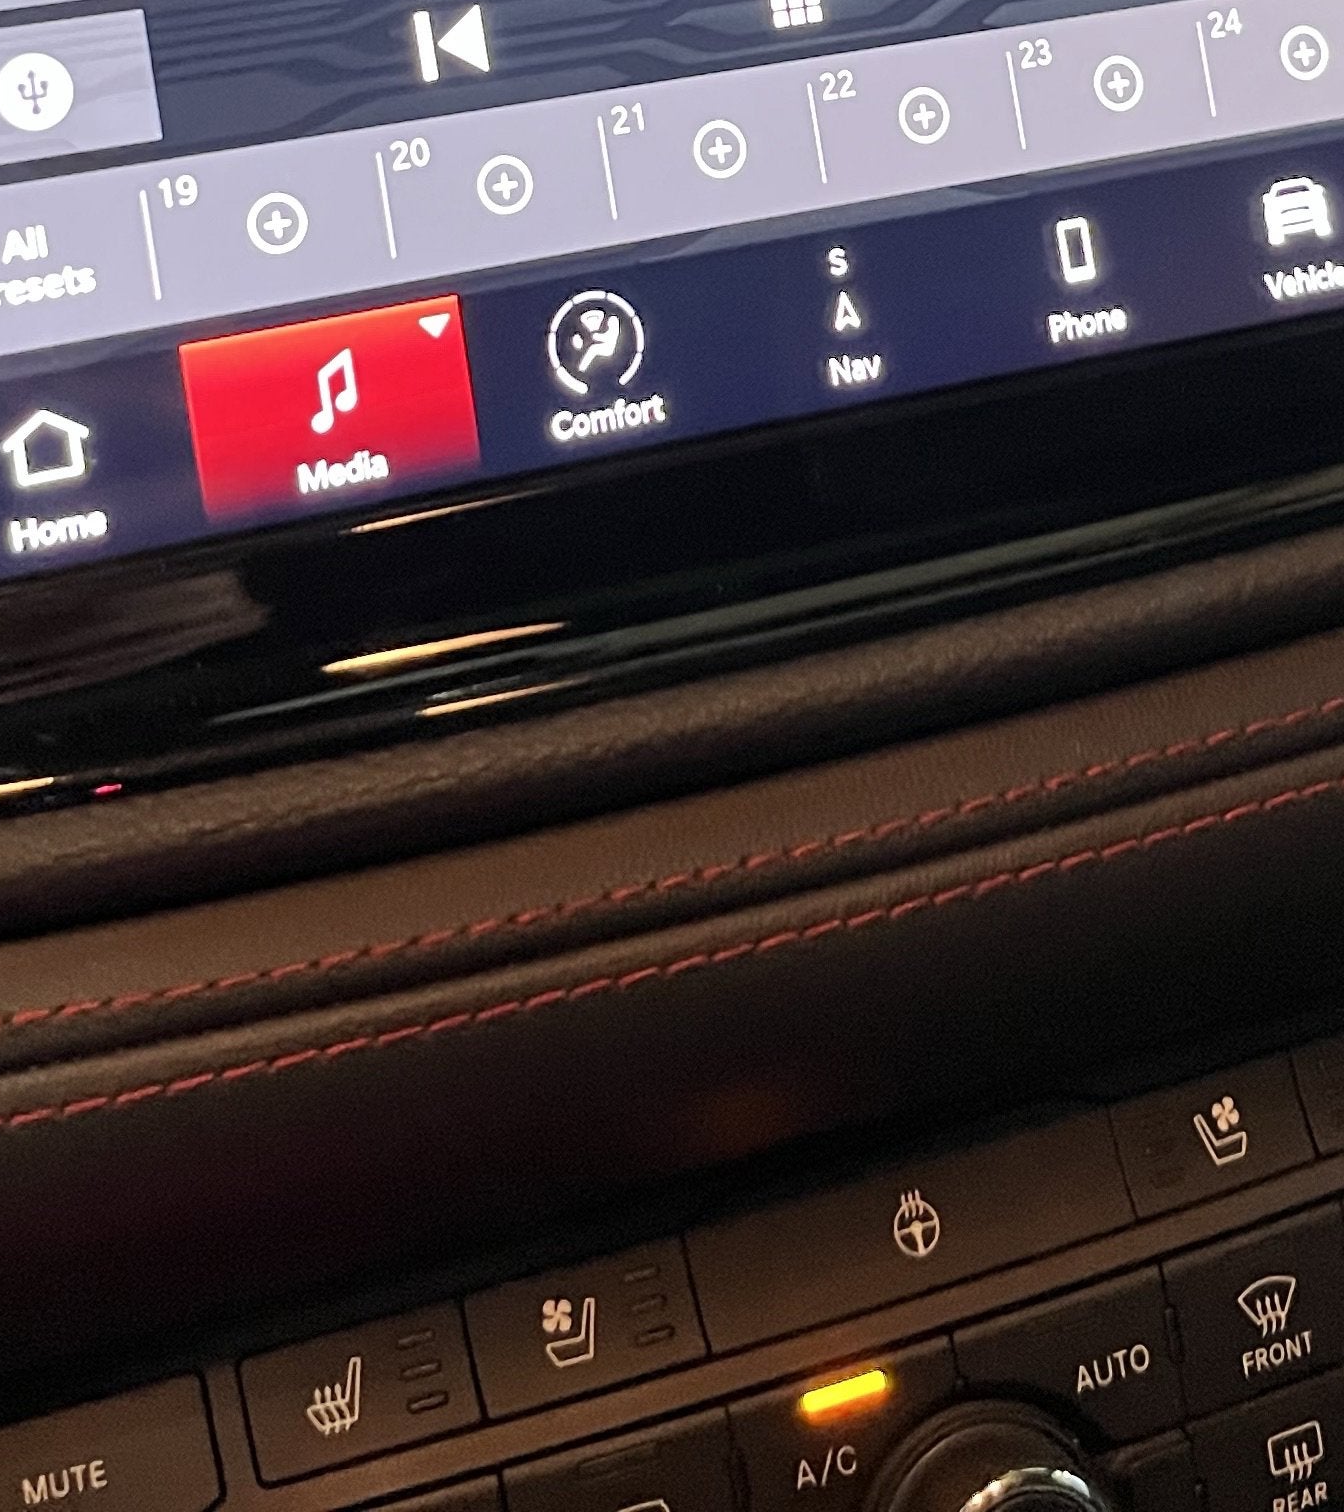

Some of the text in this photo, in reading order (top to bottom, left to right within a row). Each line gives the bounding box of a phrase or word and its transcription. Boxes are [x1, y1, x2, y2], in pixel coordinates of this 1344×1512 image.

[1206, 6, 1244, 40] 24
[1017, 37, 1054, 71] 23
[818, 68, 858, 103] 22
[609, 101, 646, 137] 21
[388, 136, 432, 173] 20
[156, 173, 199, 210] 19
[0, 223, 50, 266] All
[1046, 307, 1129, 345] Phone
[826, 353, 883, 388] Nav
[548, 395, 667, 444] Comfort
[295, 449, 391, 496] Media
[6, 509, 109, 555] Home
[1076, 1343, 1151, 1394] AUTO
[1241, 1331, 1312, 1379] FRONT
[20, 1458, 109, 1506] MUTE
[796, 1444, 858, 1491] A/C
[1271, 1480, 1329, 1512] REAR
